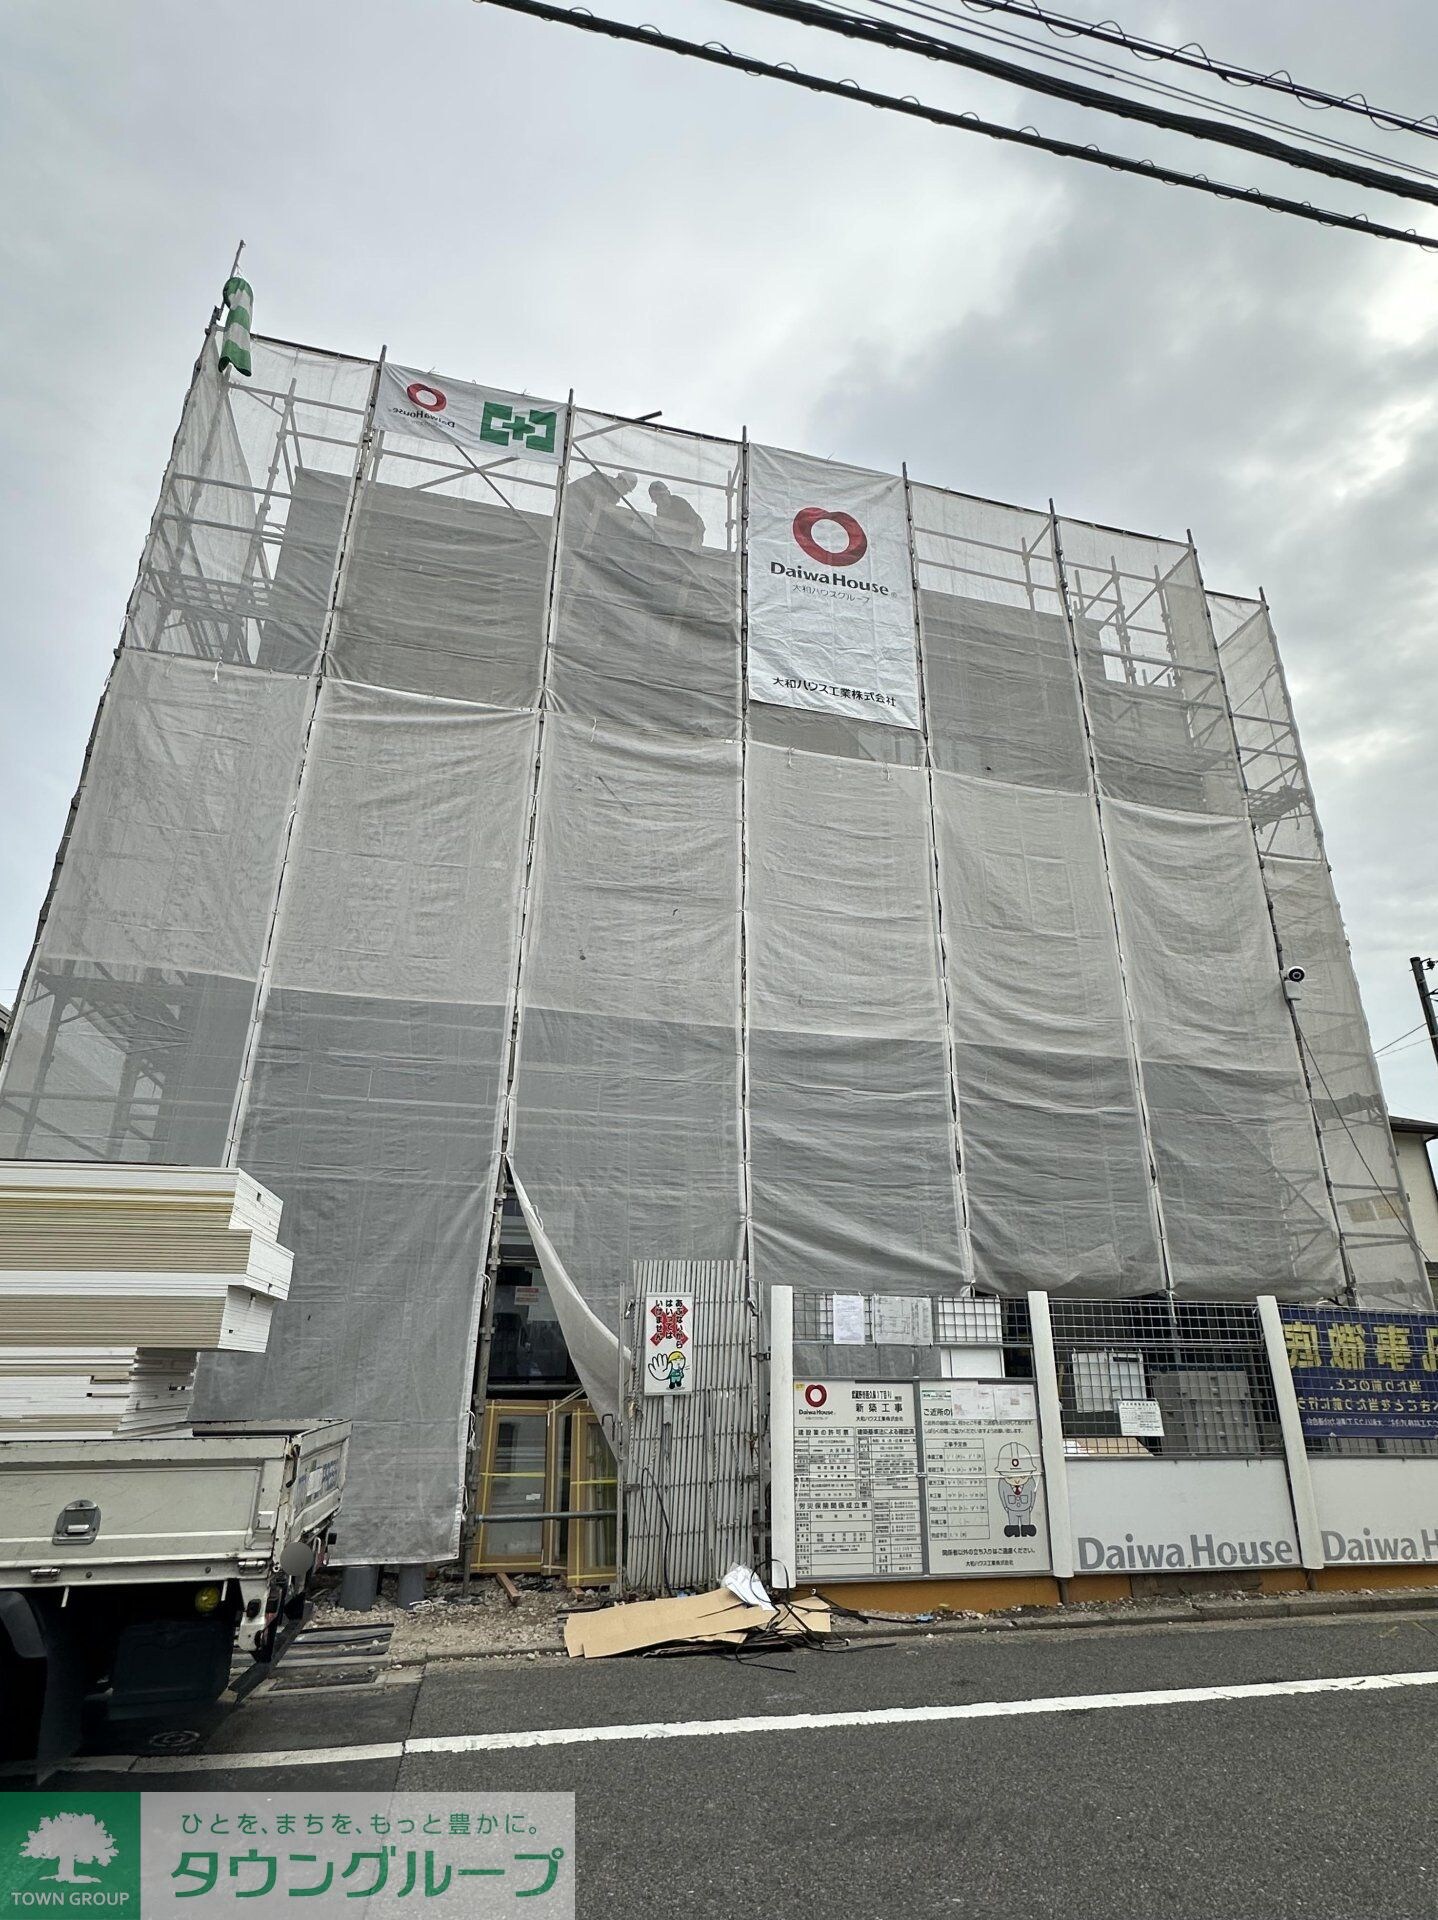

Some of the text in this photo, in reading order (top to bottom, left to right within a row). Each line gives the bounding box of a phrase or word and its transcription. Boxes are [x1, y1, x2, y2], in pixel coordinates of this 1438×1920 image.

[770, 561, 830, 584] Daiwa
[793, 583, 870, 605] 大和ハウスグループ
[773, 676, 897, 707] 大和ハウス工業株式会社
[655, 1299, 664, 1344] いけません
[665, 1299, 674, 1340] はいっては
[675, 1299, 684, 1349] あぶないから
[855, 1402, 903, 1413] 新築工事
[923, 1407, 953, 1417] ご近所の
[797, 1428, 850, 1436] 建設業の許可票
[798, 1501, 868, 1510] 労災保険関係成立票
[1077, 1533, 1293, 1571] Daiwa House
[1320, 1527, 1418, 1562] Daiwa
